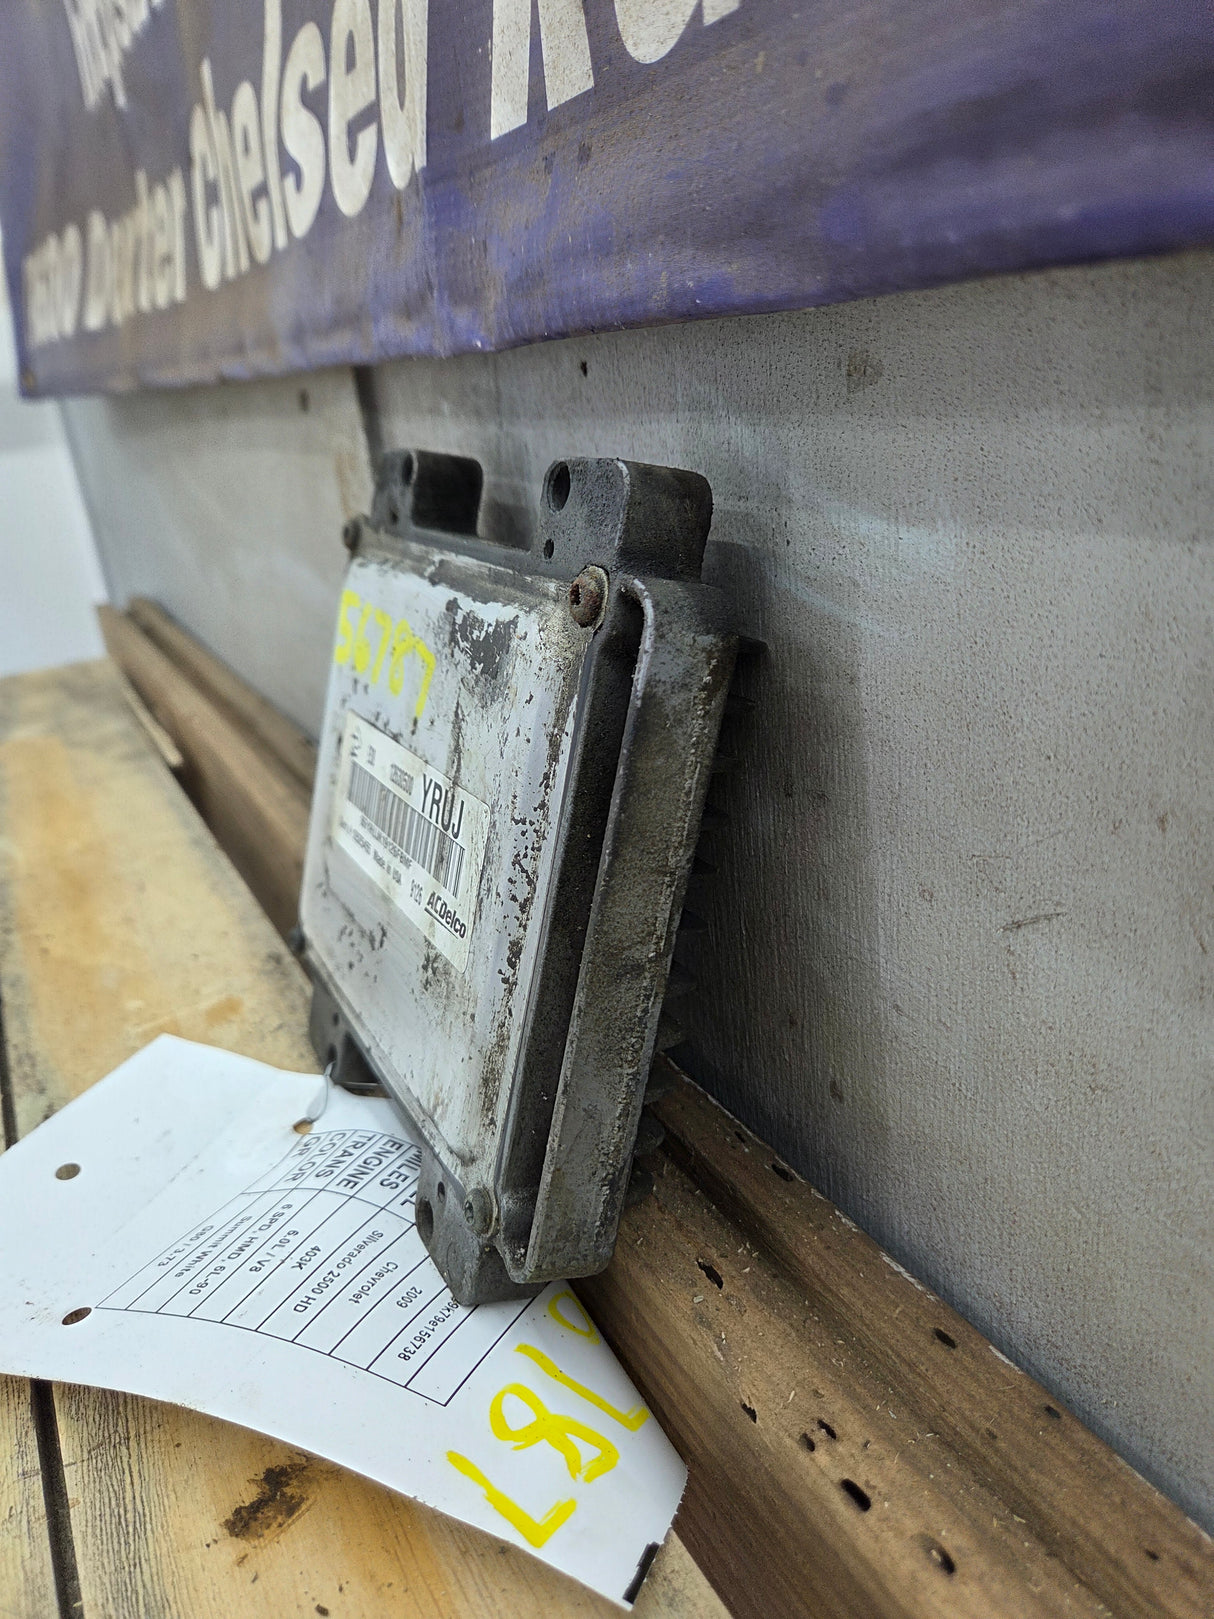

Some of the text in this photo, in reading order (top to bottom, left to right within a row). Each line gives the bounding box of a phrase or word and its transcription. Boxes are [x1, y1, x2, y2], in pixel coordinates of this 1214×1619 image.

[422, 773, 465, 839] YRUJ
[426, 890, 467, 939] ACDelco
[314, 1133, 377, 1179] TRANS
[336, 1139, 405, 1190] ENGINE
[174, 1132, 347, 1278] COLOR Summit White
[271, 1230, 299, 1250] 6.0L
[291, 1245, 321, 1270] 403K
[249, 1259, 272, 1273] V8
[293, 1229, 384, 1313] Silverado 2500 HD
[348, 1261, 399, 1305] Chevrolet
[396, 1286, 423, 1309] 2009
